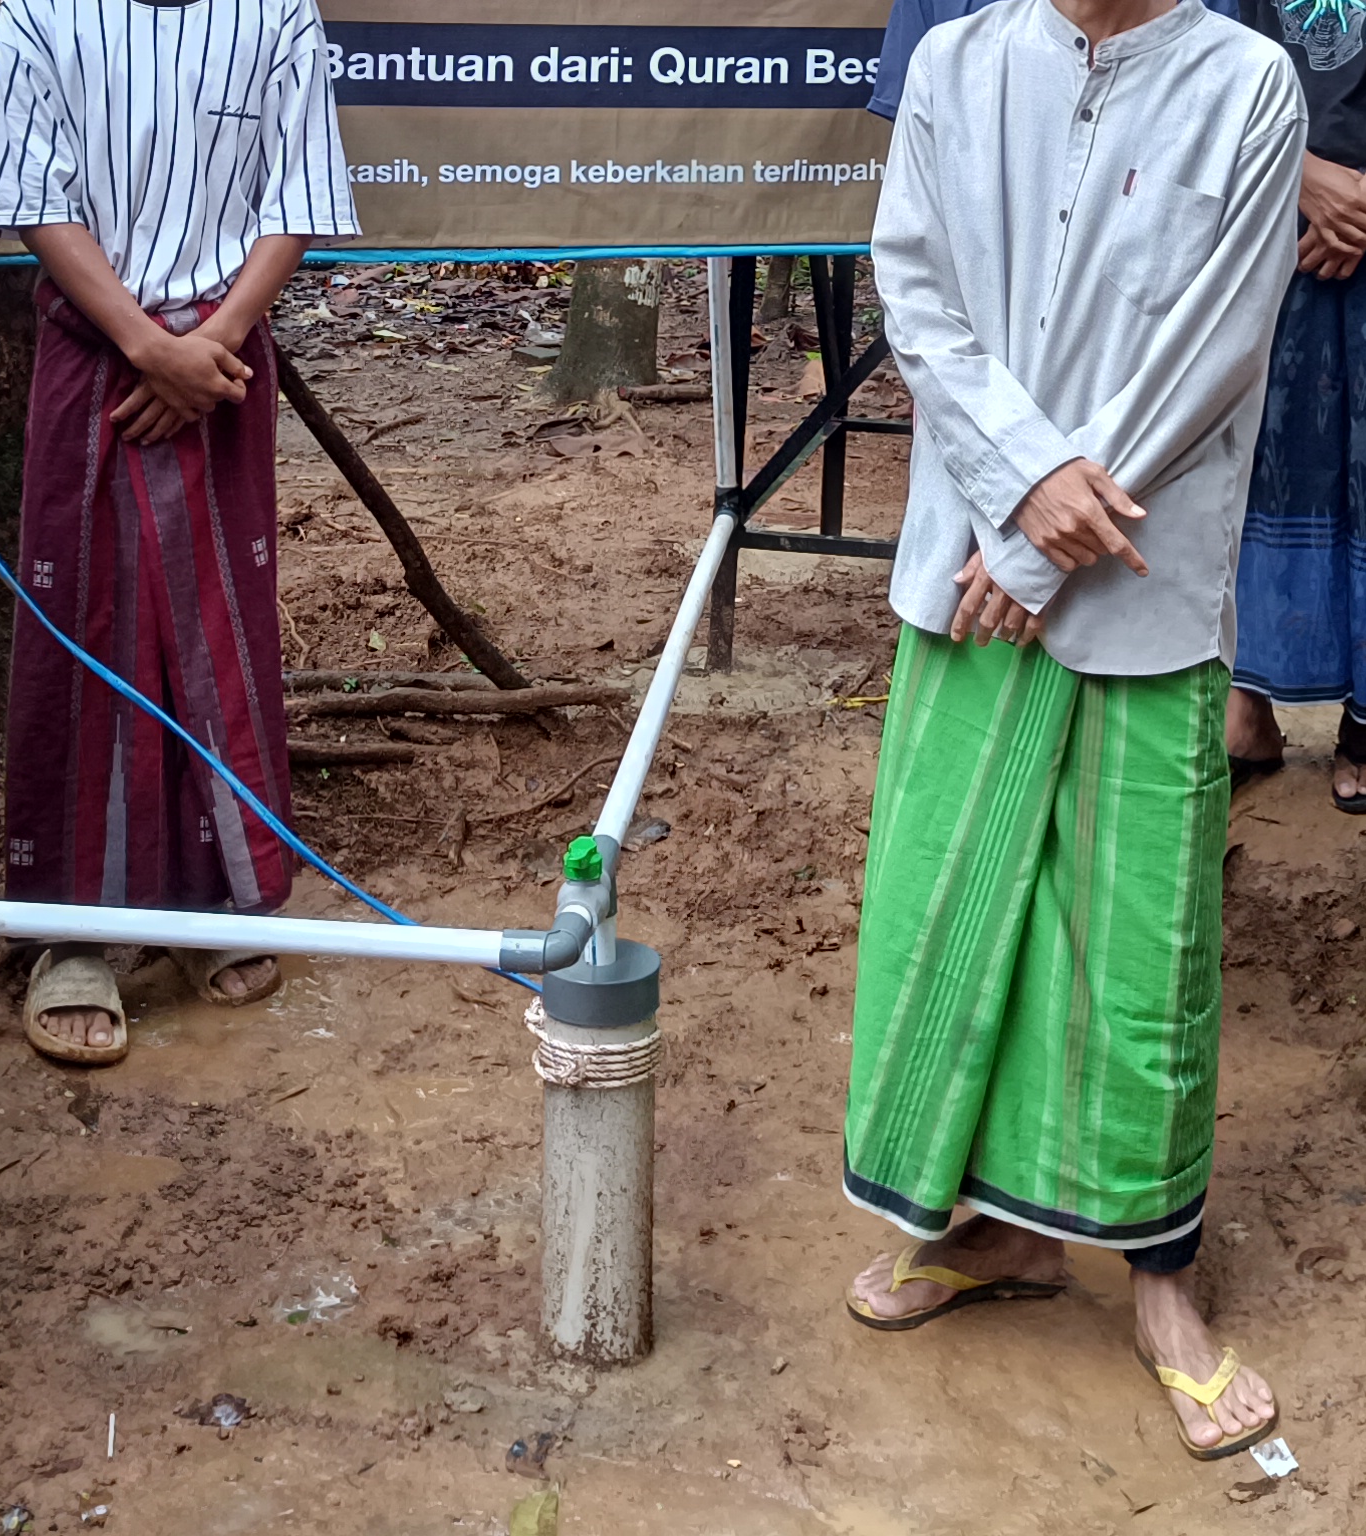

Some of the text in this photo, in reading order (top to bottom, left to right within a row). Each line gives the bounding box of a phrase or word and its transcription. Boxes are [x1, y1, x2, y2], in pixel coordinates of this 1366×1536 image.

[325, 42, 514, 82] Bantuan
[529, 46, 633, 83] dari:
[649, 46, 789, 86] Quran
[438, 162, 561, 188] semoga
[570, 159, 744, 183] keberkahan
[753, 158, 884, 187] terlimpah
